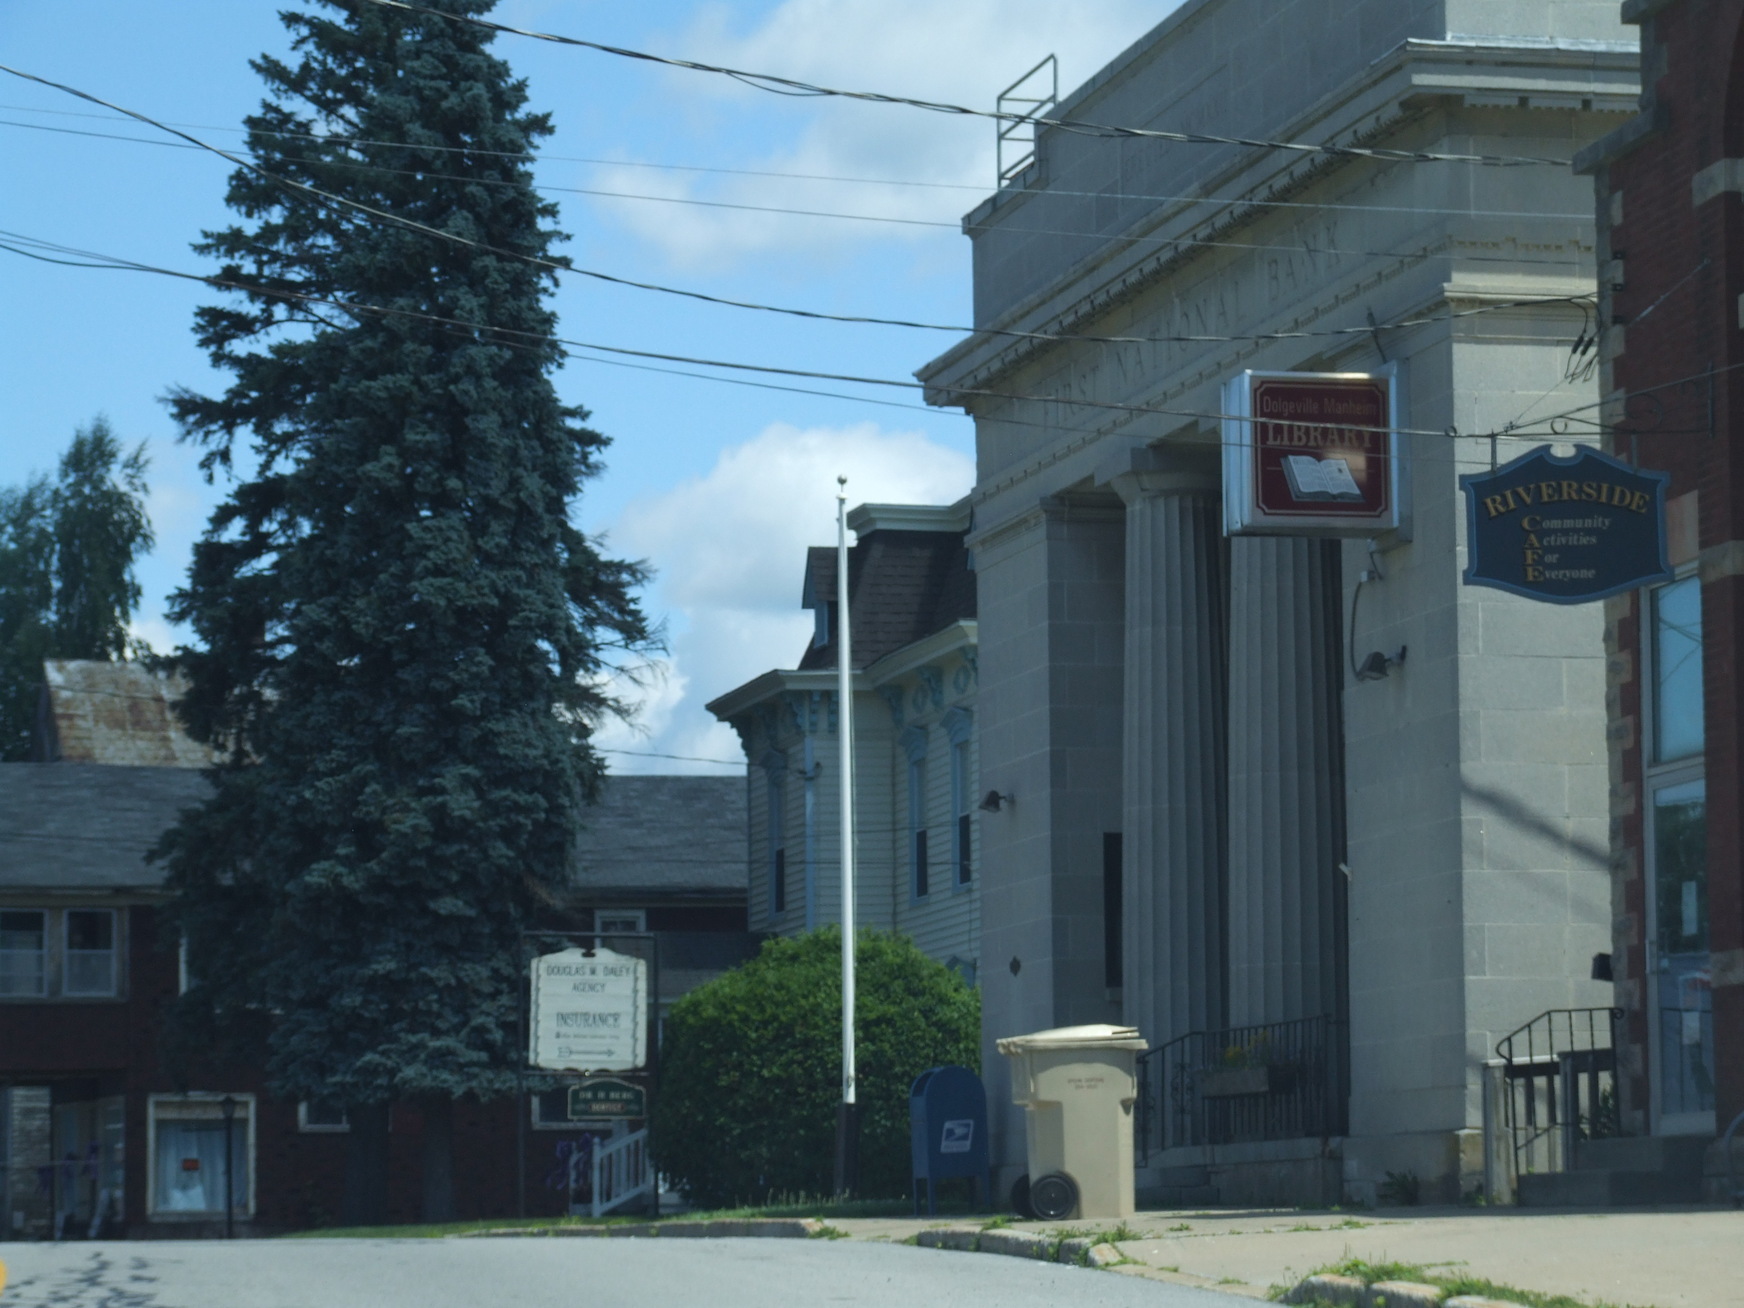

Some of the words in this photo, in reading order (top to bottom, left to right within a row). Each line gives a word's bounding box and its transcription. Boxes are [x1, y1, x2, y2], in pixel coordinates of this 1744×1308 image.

[1115, 280, 1246, 386] NATIONAL
[1267, 222, 1342, 303] BANK
[1263, 395, 1319, 417] Dolgeville
[1323, 397, 1377, 416] Manheim
[1266, 422, 1375, 448] LIBRARY
[1484, 480, 1651, 518] RIVERSIDE
[1521, 515, 1611, 531] Community
[1524, 532, 1598, 548] Activities
[1524, 549, 1560, 565] For
[1524, 566, 1596, 583] Everyone
[546, 965, 586, 977] DOUGLAS
[571, 982, 606, 993] AGENCY
[556, 1011, 622, 1029] INSURANCE
